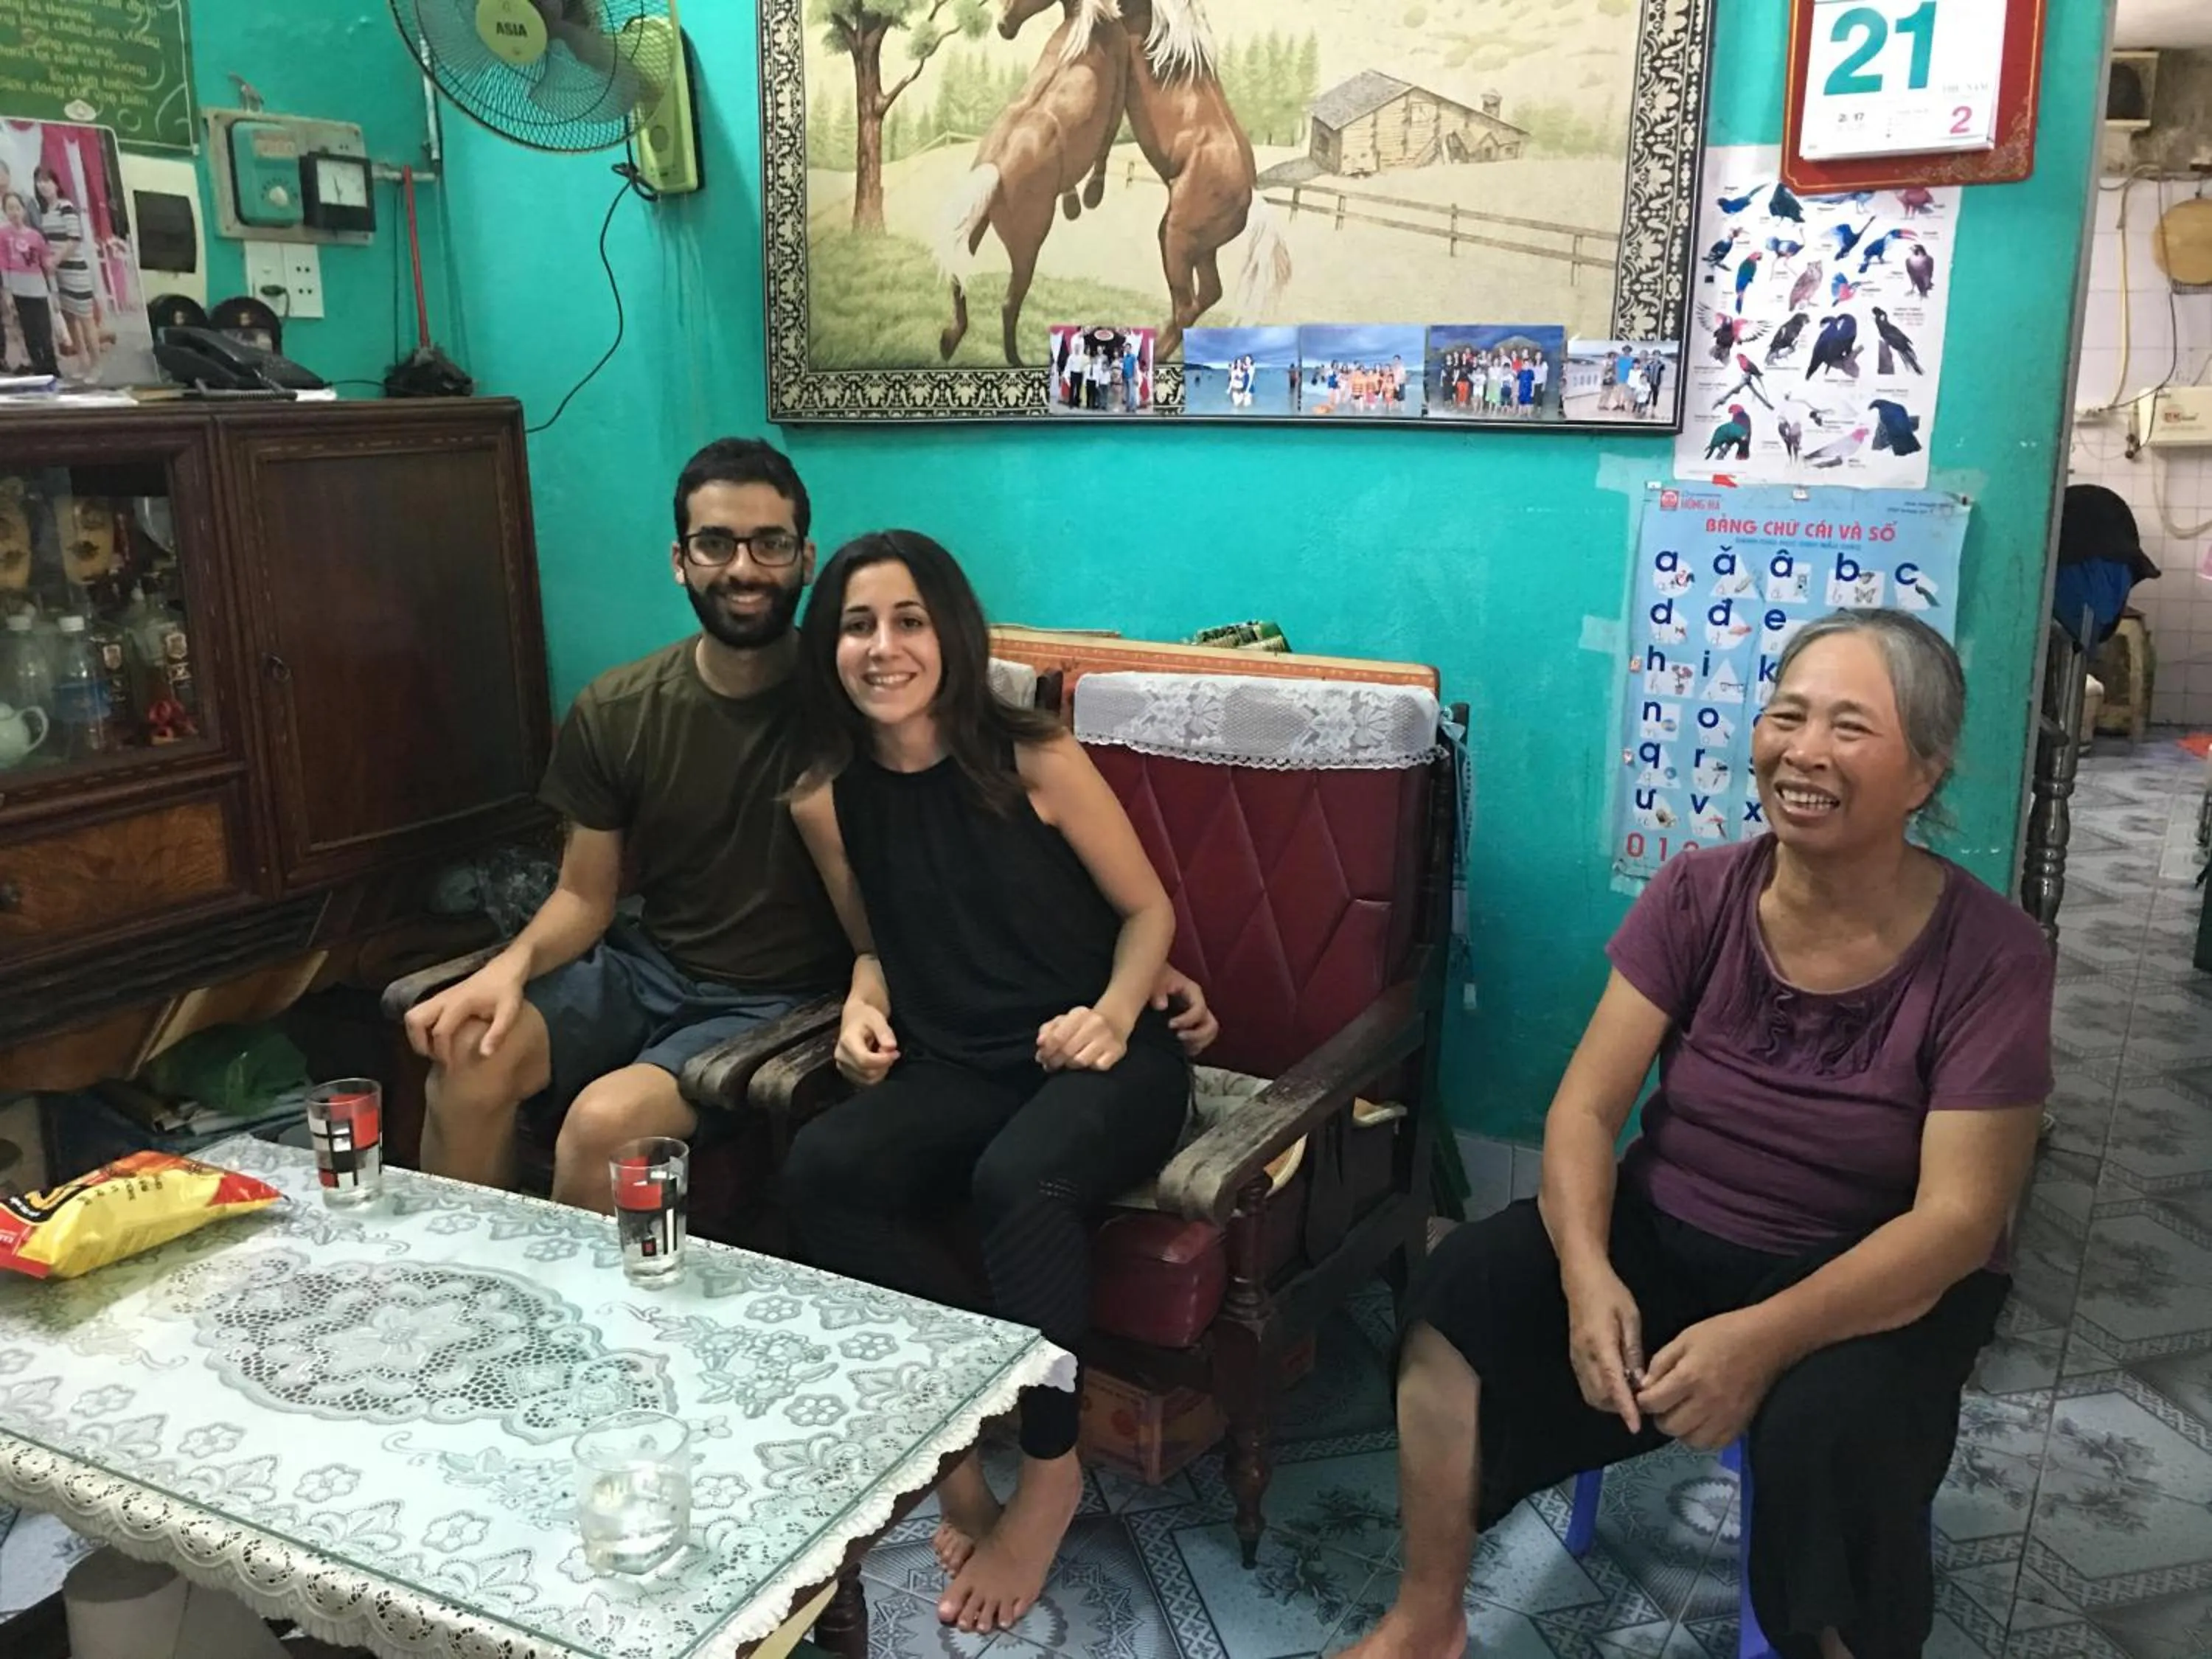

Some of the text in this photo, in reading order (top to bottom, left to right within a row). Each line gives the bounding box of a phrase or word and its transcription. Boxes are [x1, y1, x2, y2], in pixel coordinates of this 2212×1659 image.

[495, 21, 528, 38] ASIA
[1823, 1, 1937, 96] 21
[1950, 105, 1972, 134] 2
[1705, 513, 1899, 542] BẢNG CHỮ CÁI VÀ SỐ
[1655, 545, 1919, 585] a ă â b c
[1650, 598, 1787, 631] d đ e
[1646, 644, 1776, 684] h i k
[1643, 701, 1719, 728] n o
[1639, 742, 1705, 768] q r
[1635, 788, 1762, 822] ư v x
[1658, 837, 1667, 862] 1
